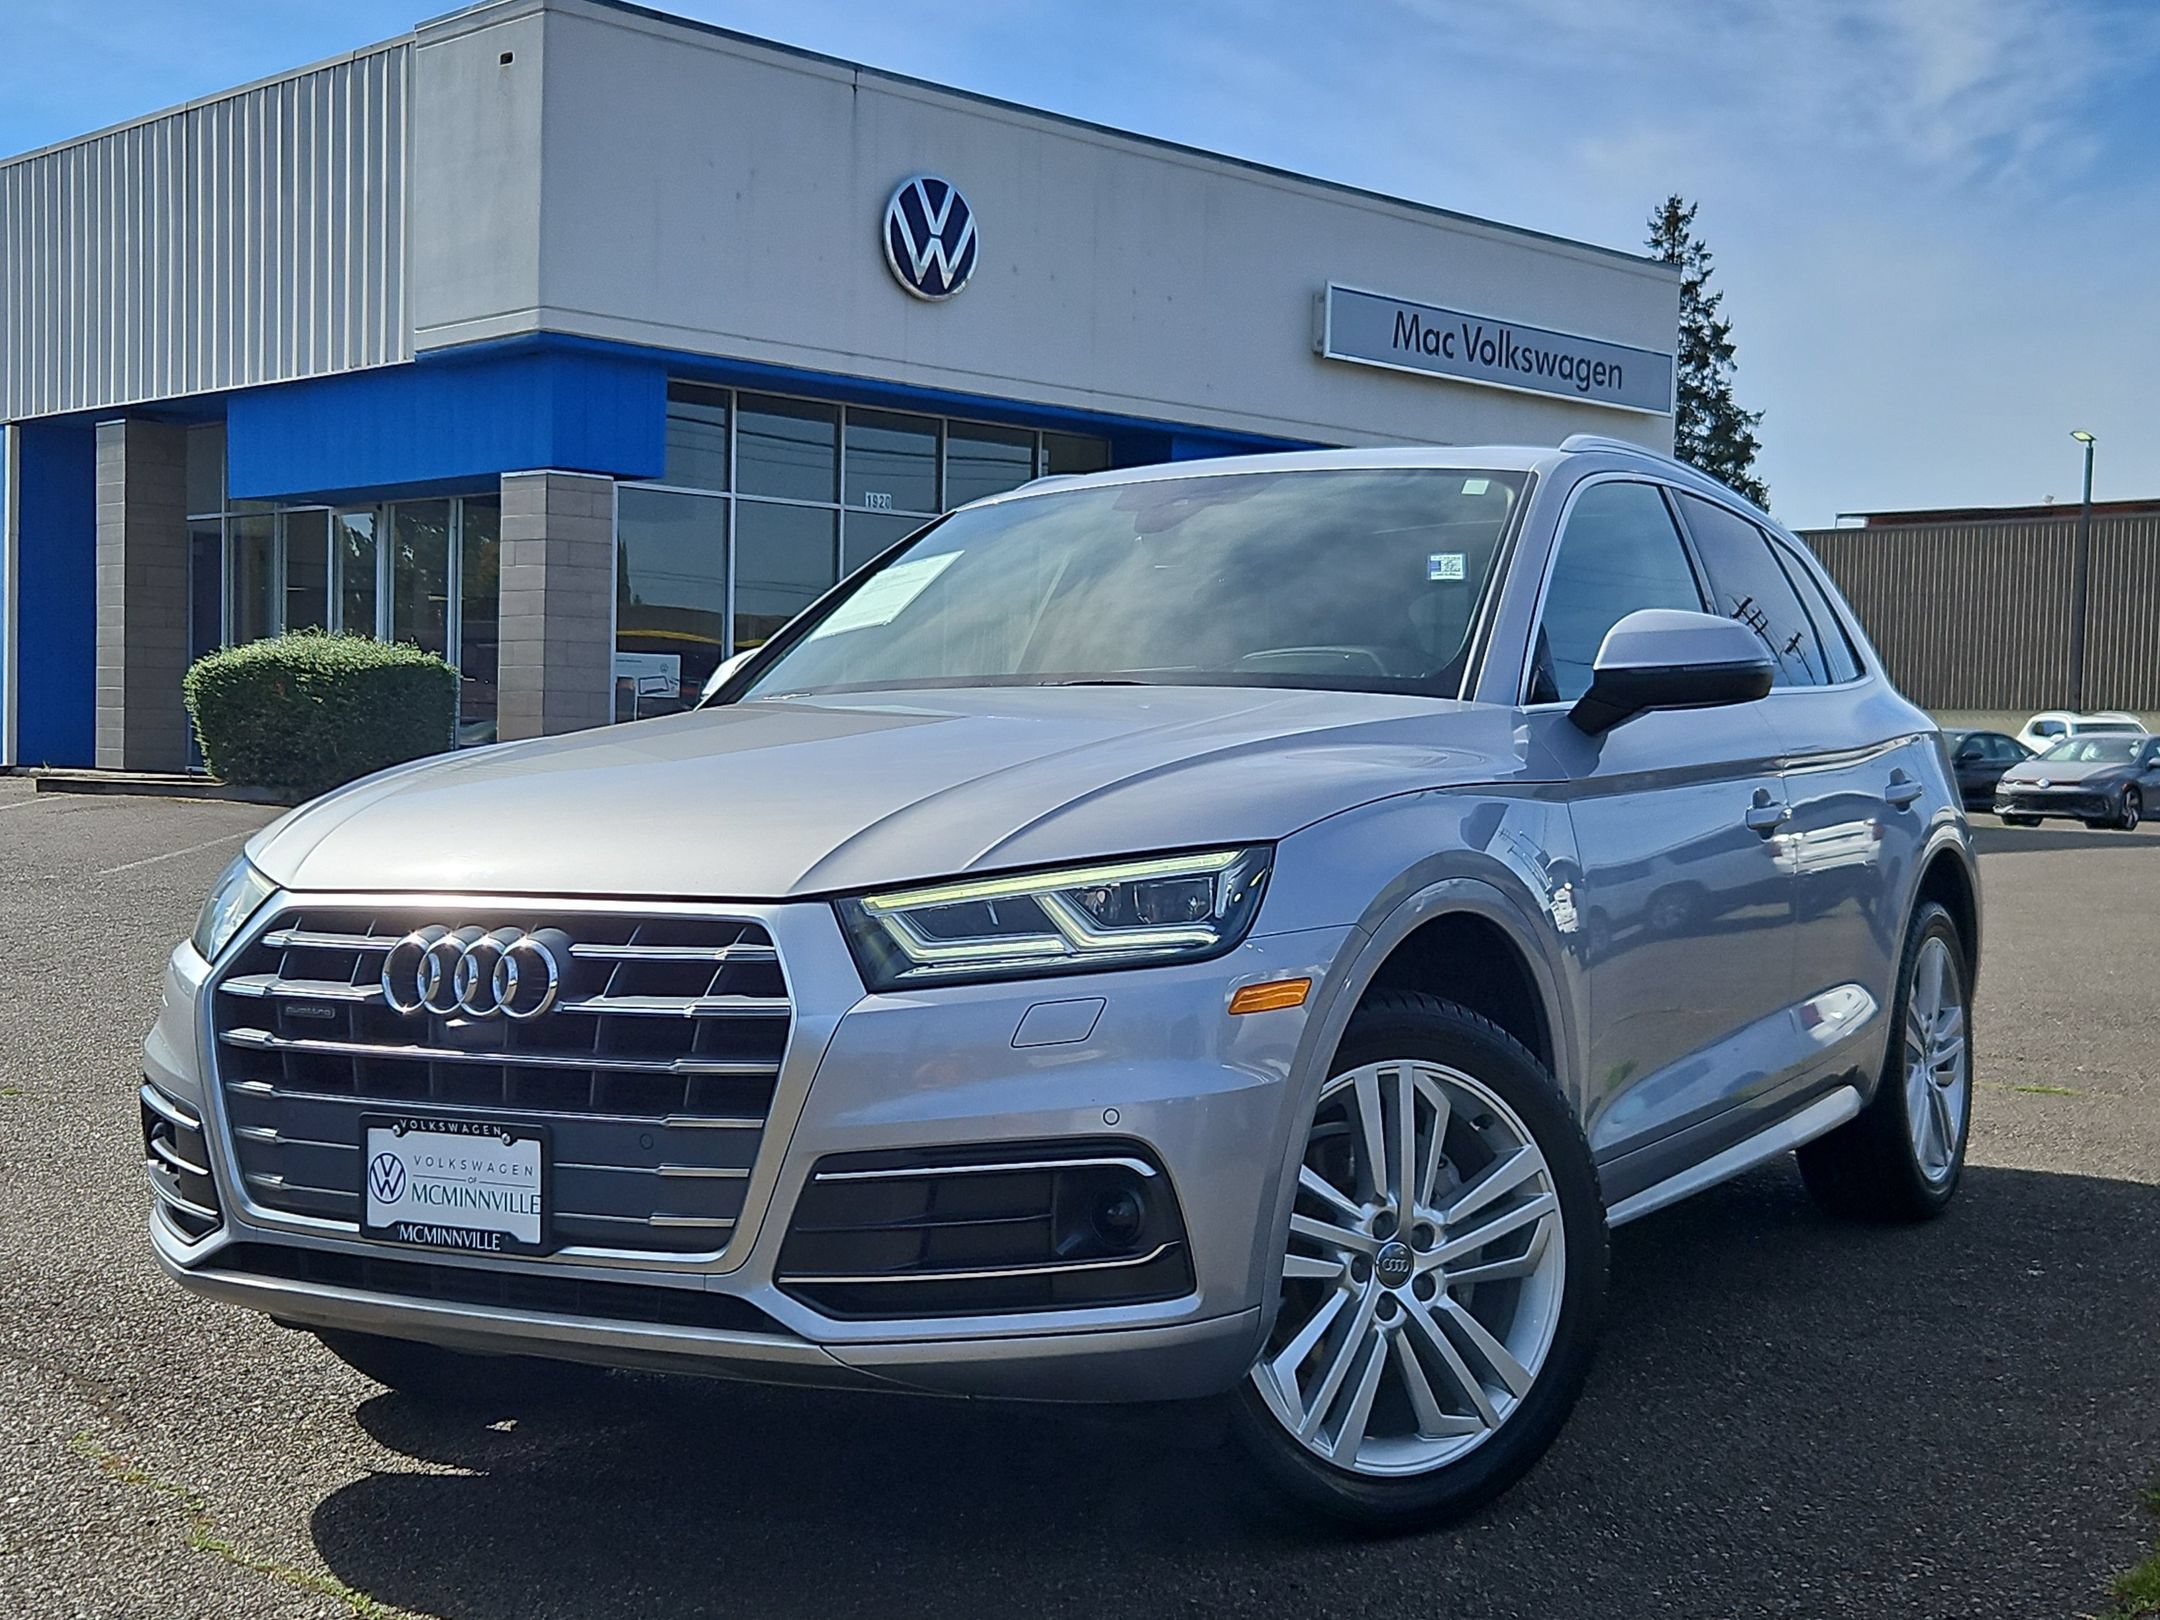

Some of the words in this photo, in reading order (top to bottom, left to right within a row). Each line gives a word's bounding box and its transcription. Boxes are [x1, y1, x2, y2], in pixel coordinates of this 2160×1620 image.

[1392, 310, 1455, 360] Mac
[1461, 323, 1622, 392] Volkswagen
[867, 494, 891, 509] 1920
[400, 1119, 501, 1135] VOLKSWAGEN
[413, 1155, 533, 1176] VOLKSWAGEN
[411, 1182, 541, 1214] MCMINNVILLE
[399, 1224, 501, 1250] MCMINNVILLE
